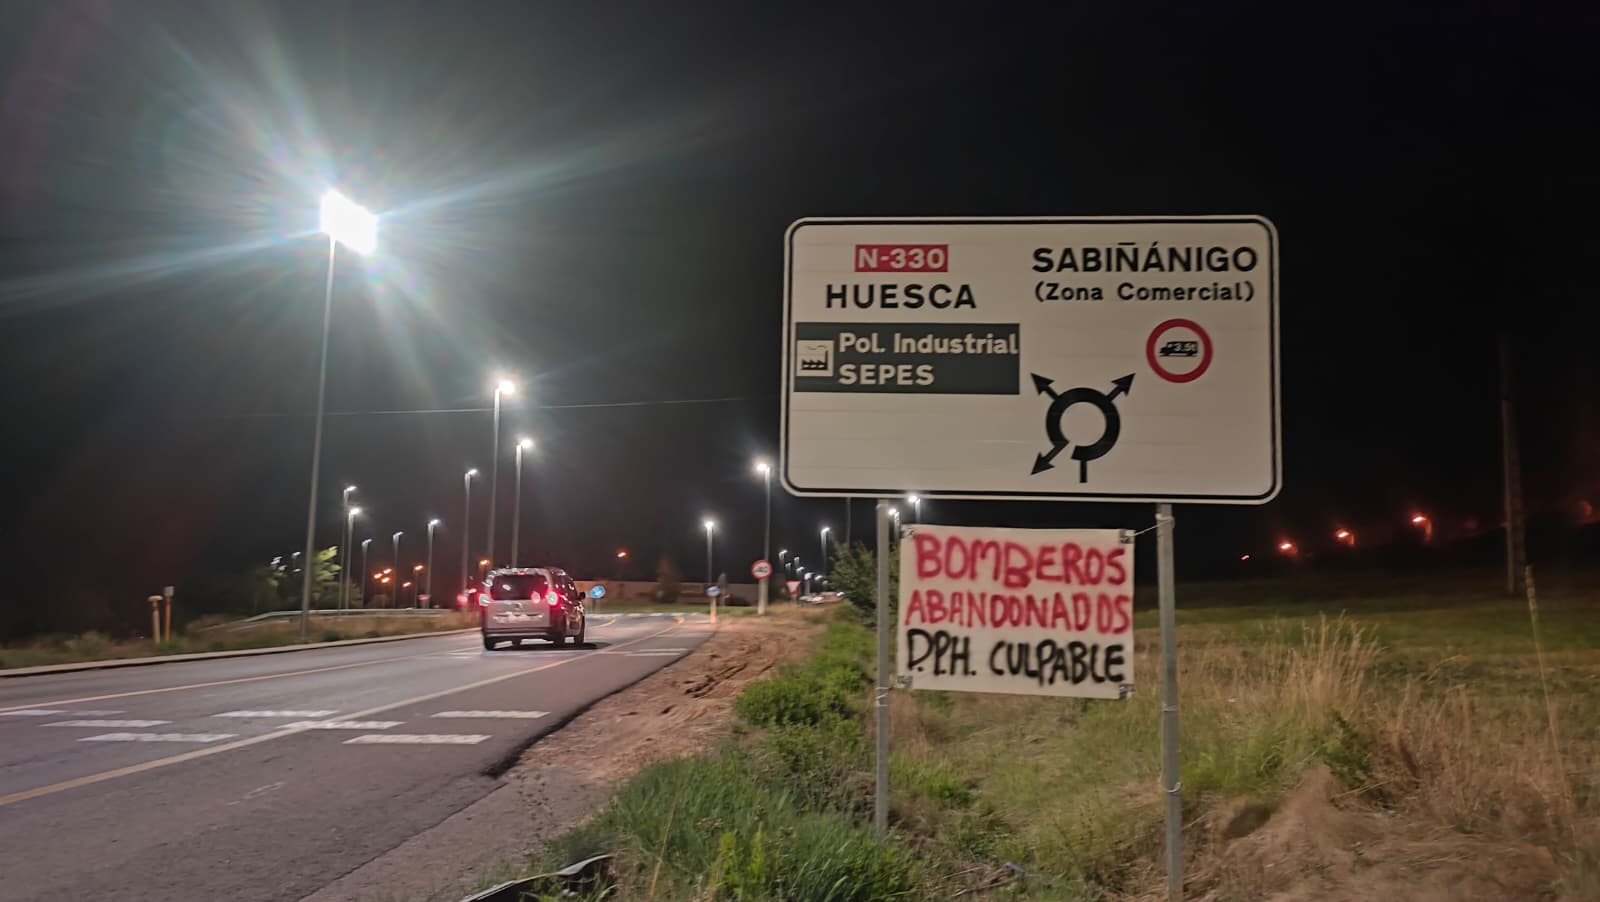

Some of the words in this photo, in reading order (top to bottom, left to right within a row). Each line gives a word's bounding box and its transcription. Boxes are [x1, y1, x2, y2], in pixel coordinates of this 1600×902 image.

[857, 248, 945, 269] N-330
[1032, 241, 1258, 273] SABIÑÁNIGO
[826, 284, 977, 309] HUESCA
[1035, 281, 1104, 302] (Zona
[1117, 281, 1254, 302] Comercial)
[838, 332, 886, 353] Pol.
[893, 333, 1019, 355] Industrial
[838, 364, 935, 386] SEPES
[913, 533, 1126, 589] BOMBEROS
[904, 589, 1131, 634] ABANDONADOS
[989, 638, 1125, 686] CULPABLE
